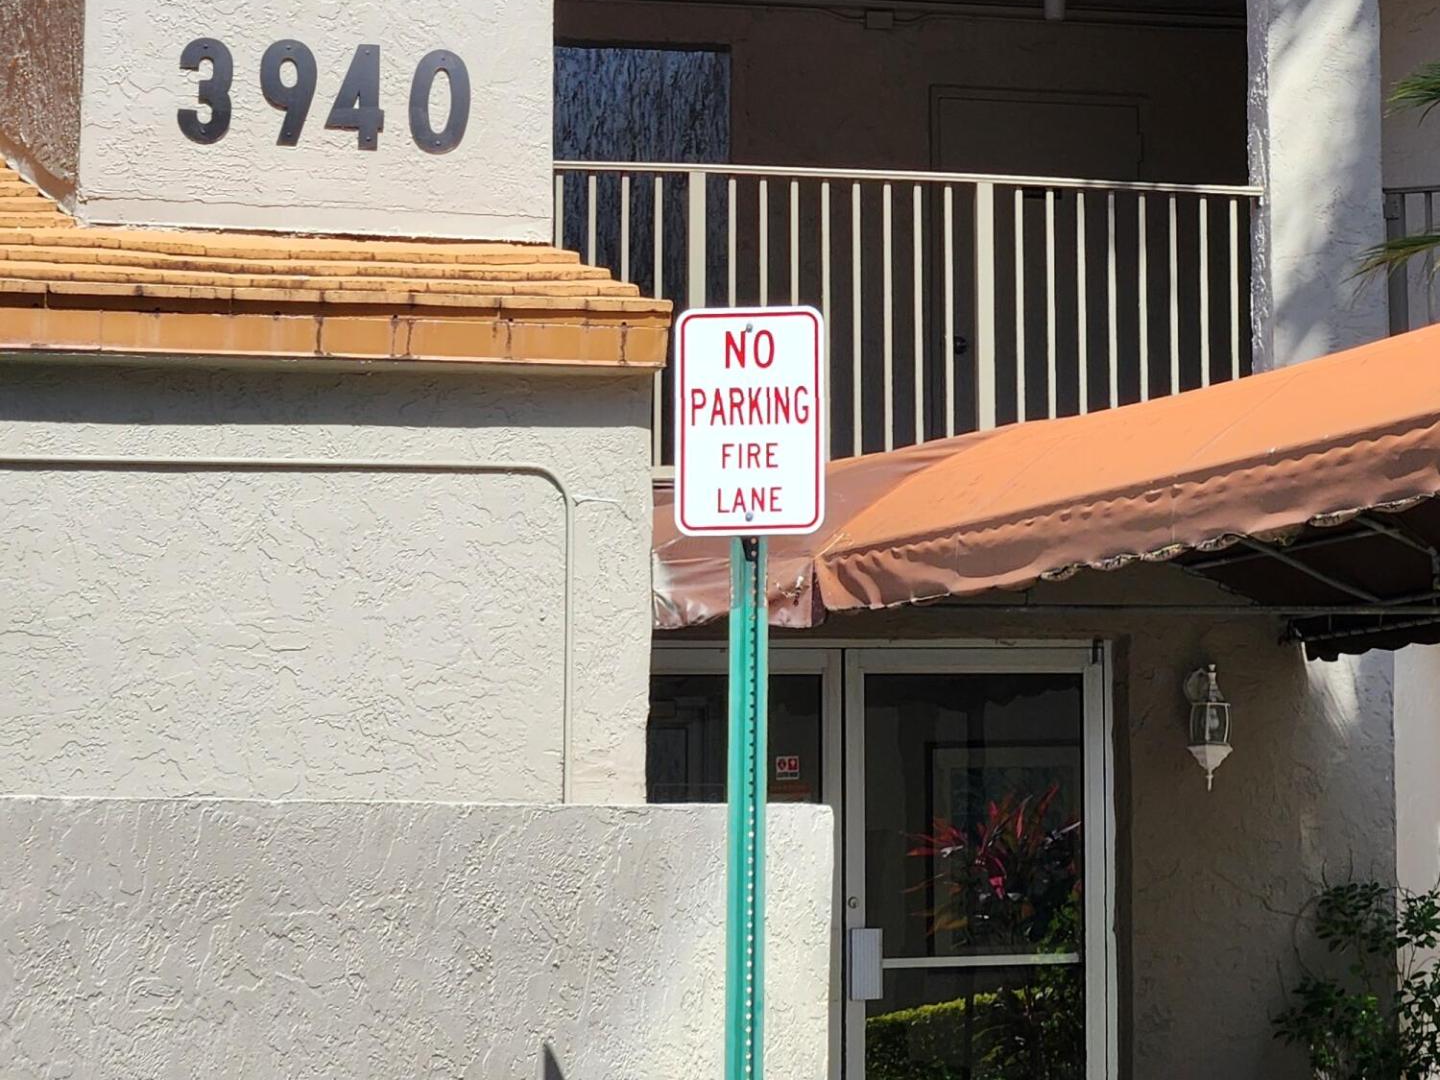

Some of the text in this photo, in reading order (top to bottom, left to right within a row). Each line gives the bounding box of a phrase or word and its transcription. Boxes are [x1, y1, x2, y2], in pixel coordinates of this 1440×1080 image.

[177, 37, 470, 154] 3940
[725, 330, 775, 369] NO
[691, 385, 809, 426] PARKING
[722, 442, 779, 469] FIRE
[718, 486, 783, 513] LANE
